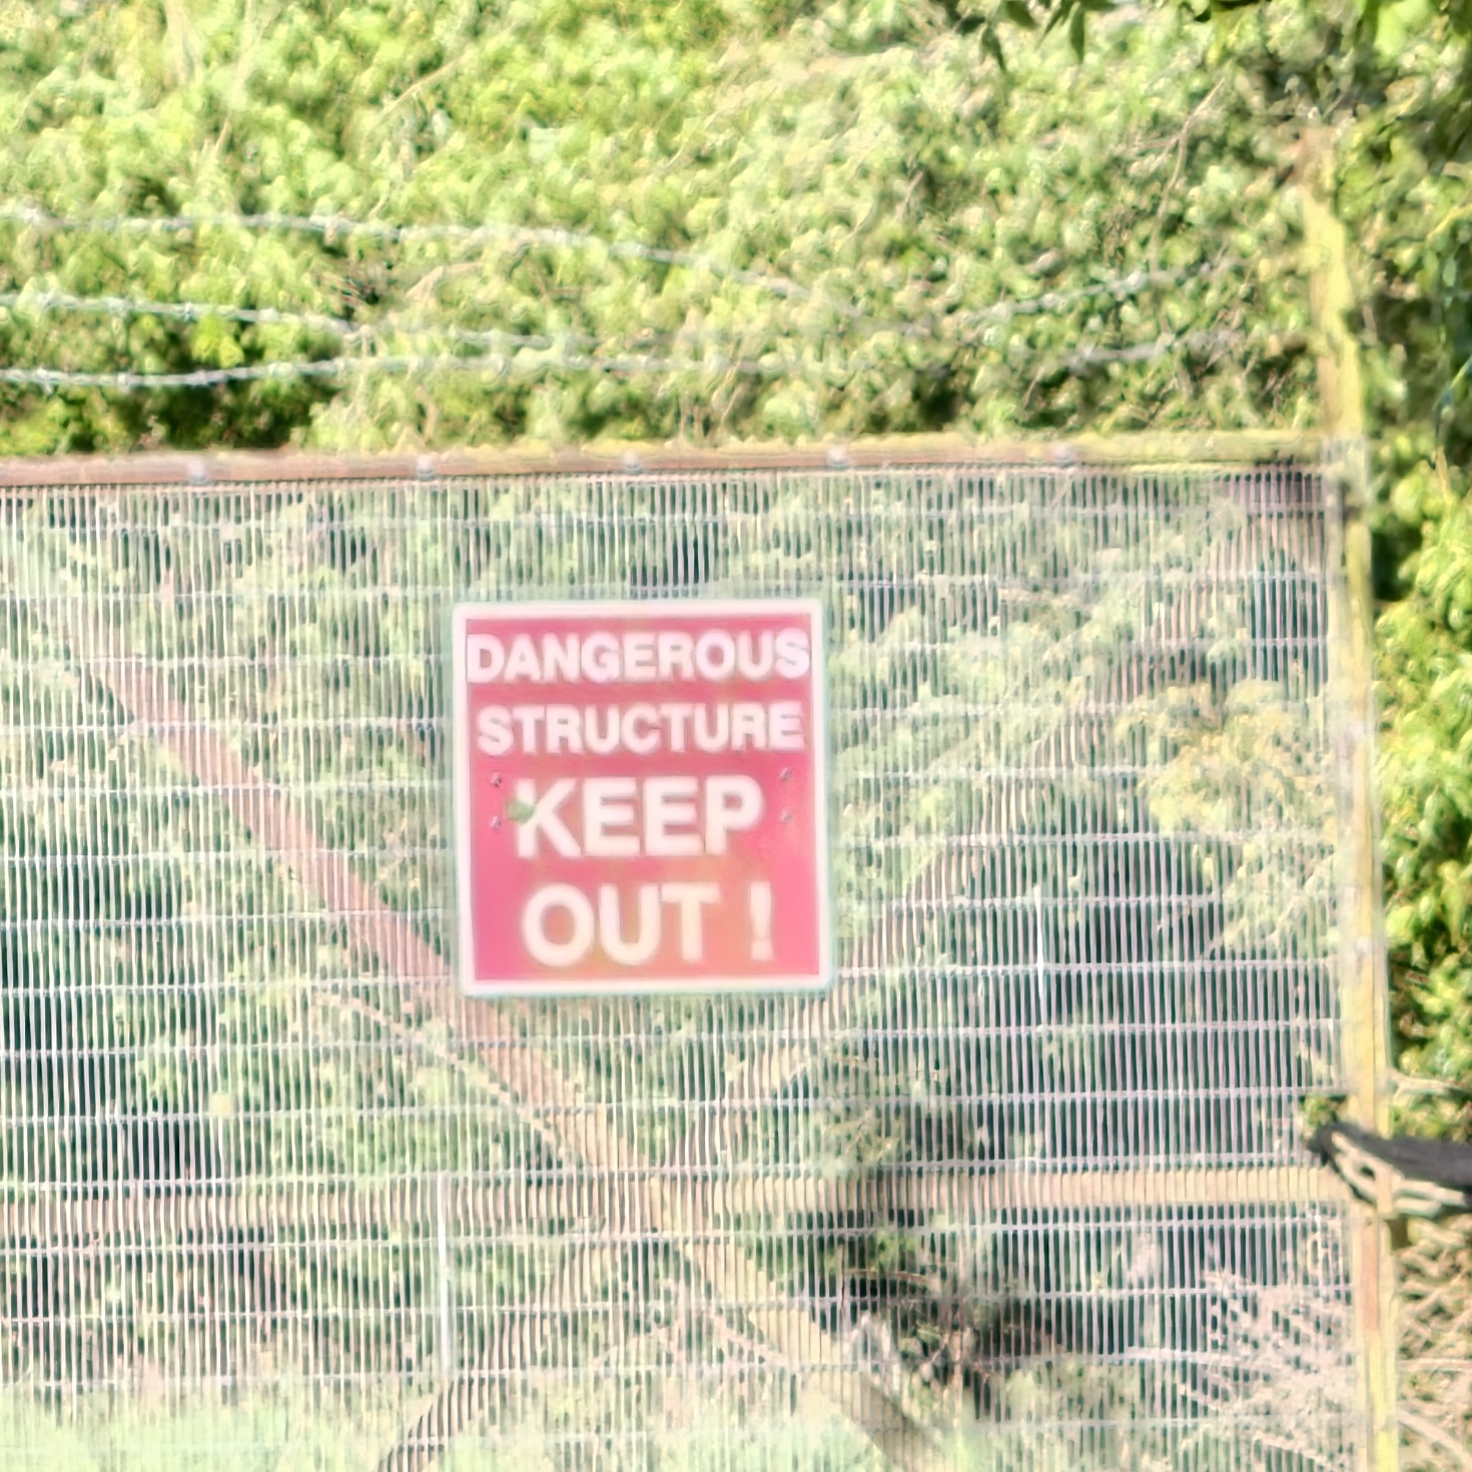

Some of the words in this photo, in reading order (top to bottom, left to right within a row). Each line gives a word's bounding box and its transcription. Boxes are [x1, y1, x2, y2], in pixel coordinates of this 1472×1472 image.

[466, 629, 811, 684] DANGEROUS
[477, 701, 805, 755] STRUCTURE
[513, 775, 765, 859] KEEP
